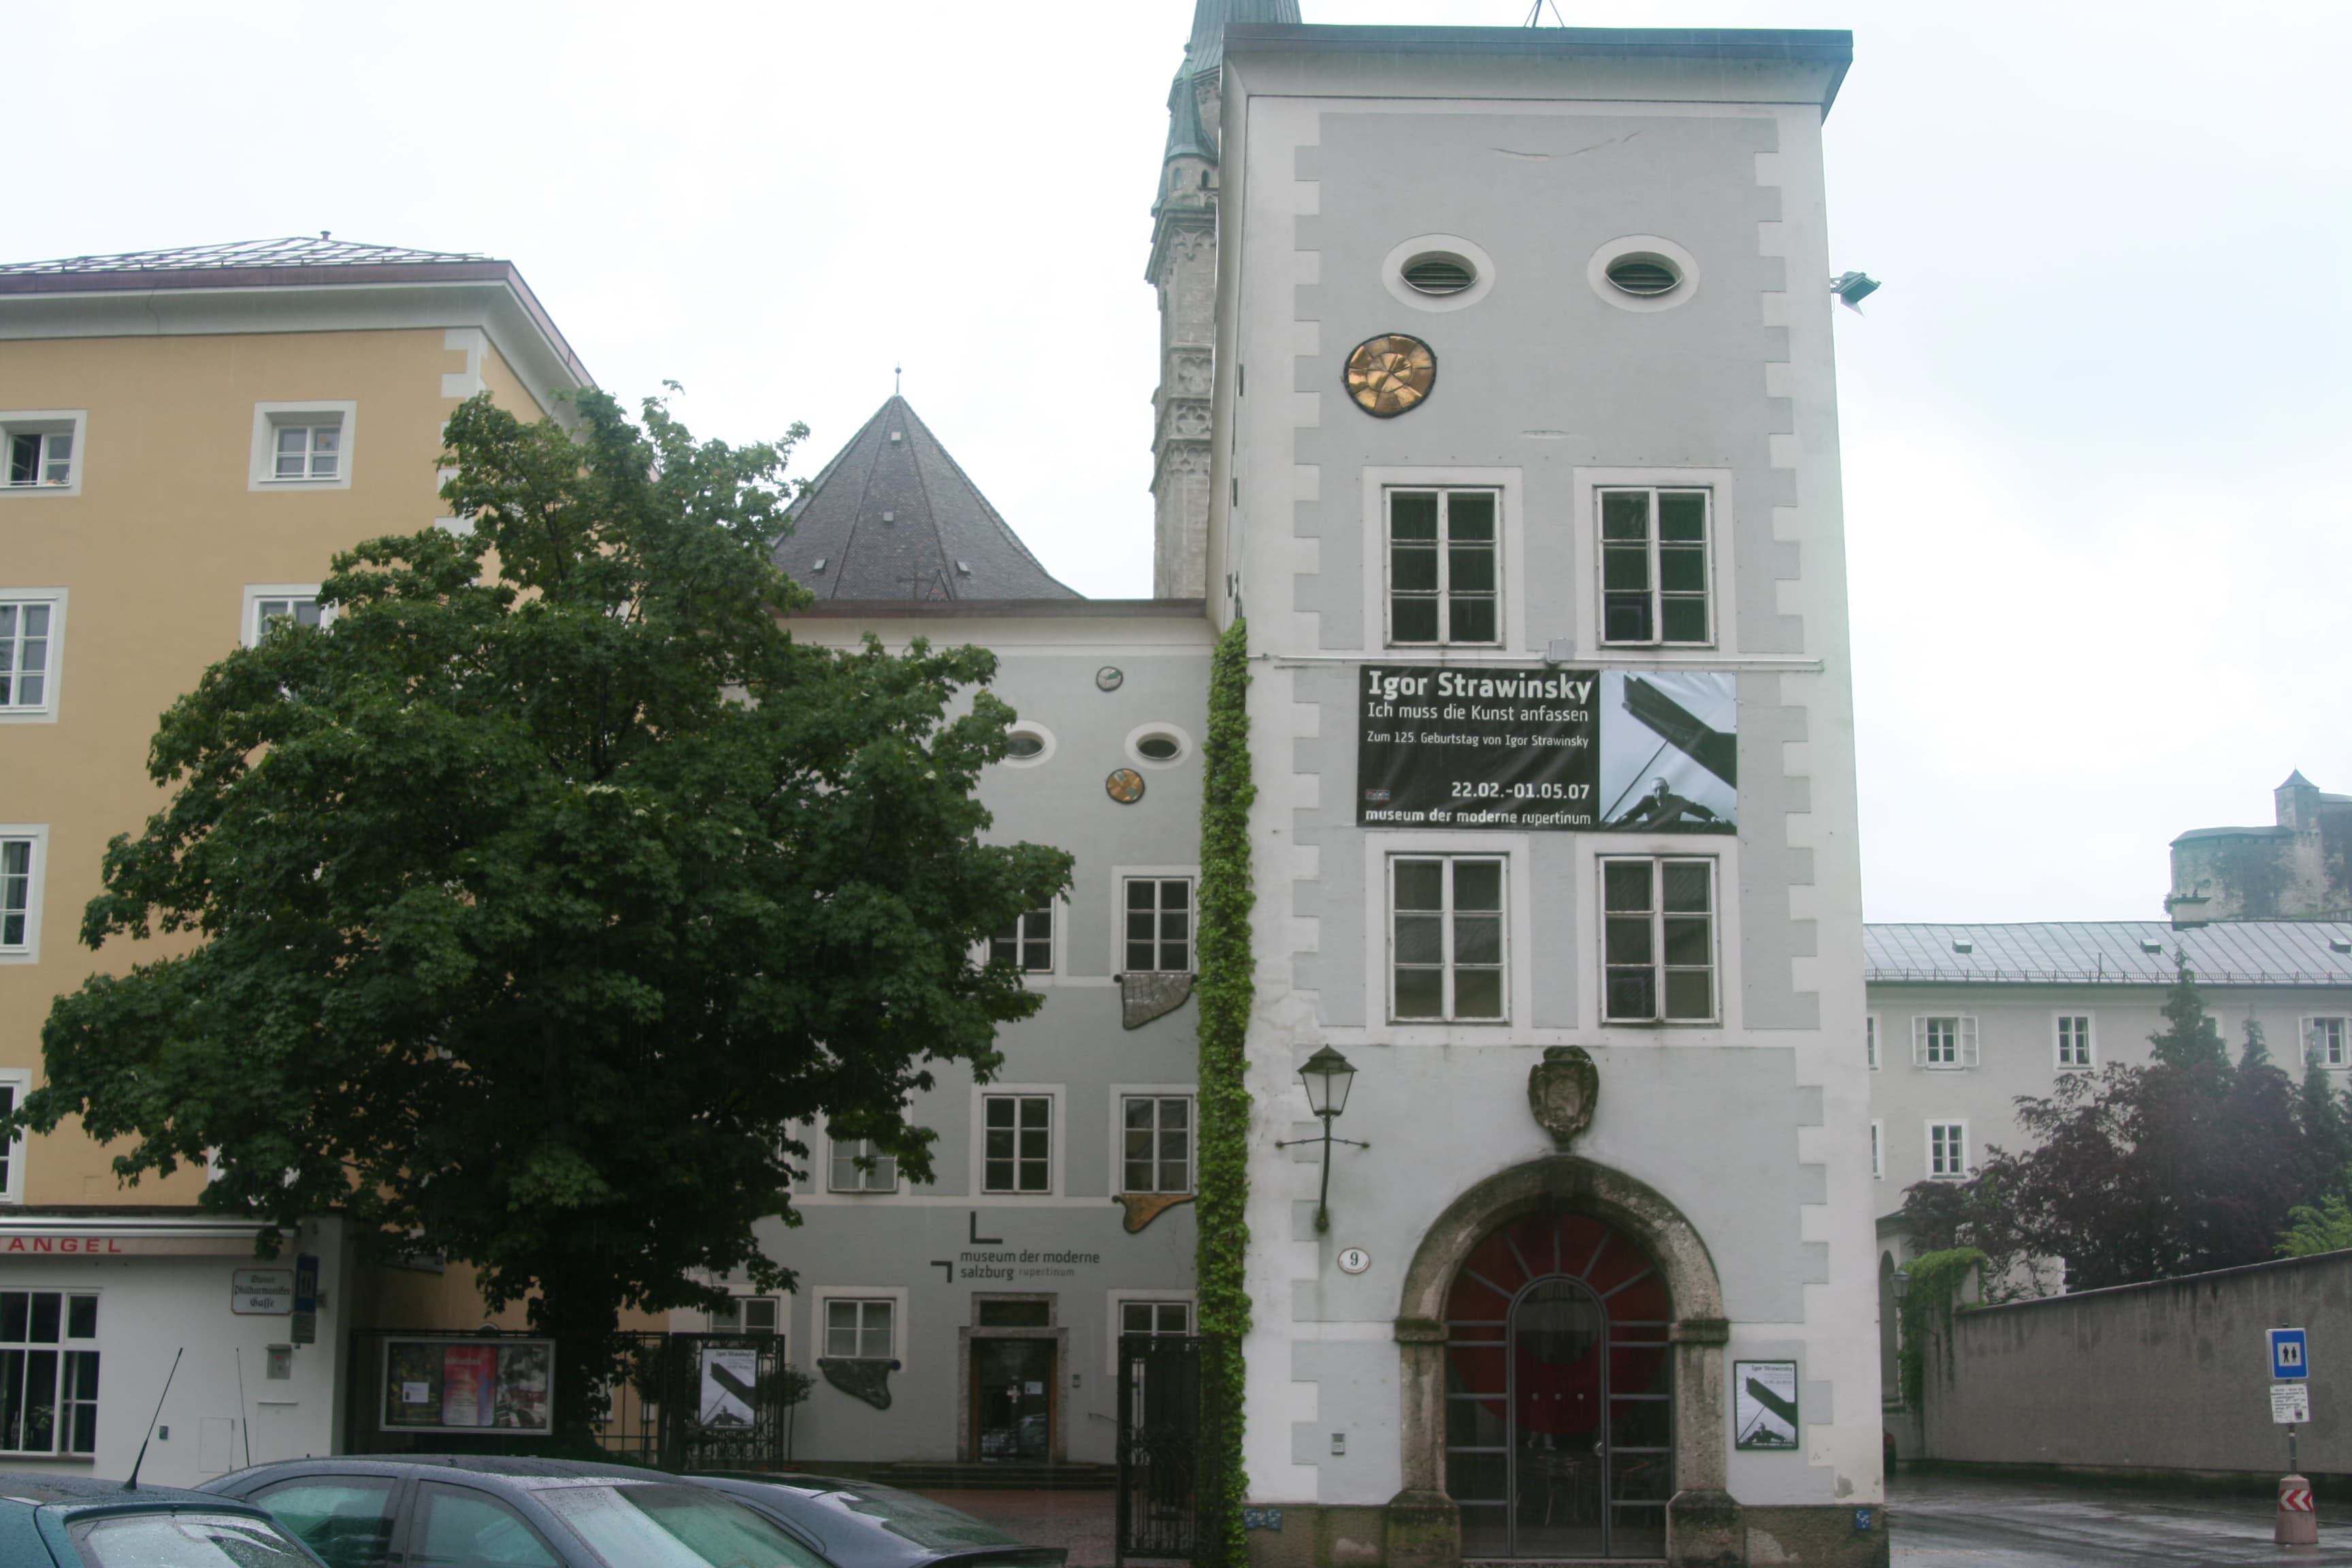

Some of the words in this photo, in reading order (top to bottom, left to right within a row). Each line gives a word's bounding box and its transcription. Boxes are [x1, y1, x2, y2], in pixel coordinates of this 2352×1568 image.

[1369, 670, 1428, 700] Igor
[1438, 672, 1592, 704] Strawinsky
[1368, 702, 1393, 718] Ich
[1399, 706, 1438, 719] muss
[1443, 704, 1466, 720] die
[1471, 705, 1514, 721] Kunst
[1520, 706, 1588, 723] anfassen
[1367, 732, 1390, 743] Zum
[1394, 732, 1418, 743] 125.
[1421, 732, 1480, 747] Geburtstag
[1483, 736, 1501, 746] von
[1505, 734, 1529, 748] Igor
[1531, 734, 1589, 749] Strawinsky
[1452, 781, 1590, 800] 22.02.-01.05.07
[1365, 808, 1424, 822] museum
[1429, 808, 1451, 823] der
[1456, 808, 1518, 823] moderne
[1522, 811, 1591, 826] rupertinum
[7, 1237, 122, 1253] ANGEL
[960, 1250, 1016, 1263] museum
[1019, 1249, 1041, 1263] der
[1043, 1250, 1100, 1264] moderne
[1350, 1252, 1358, 1266] 9
[960, 1264, 1015, 1281] salzburg
[1018, 1267, 1075, 1277] rupertinum
